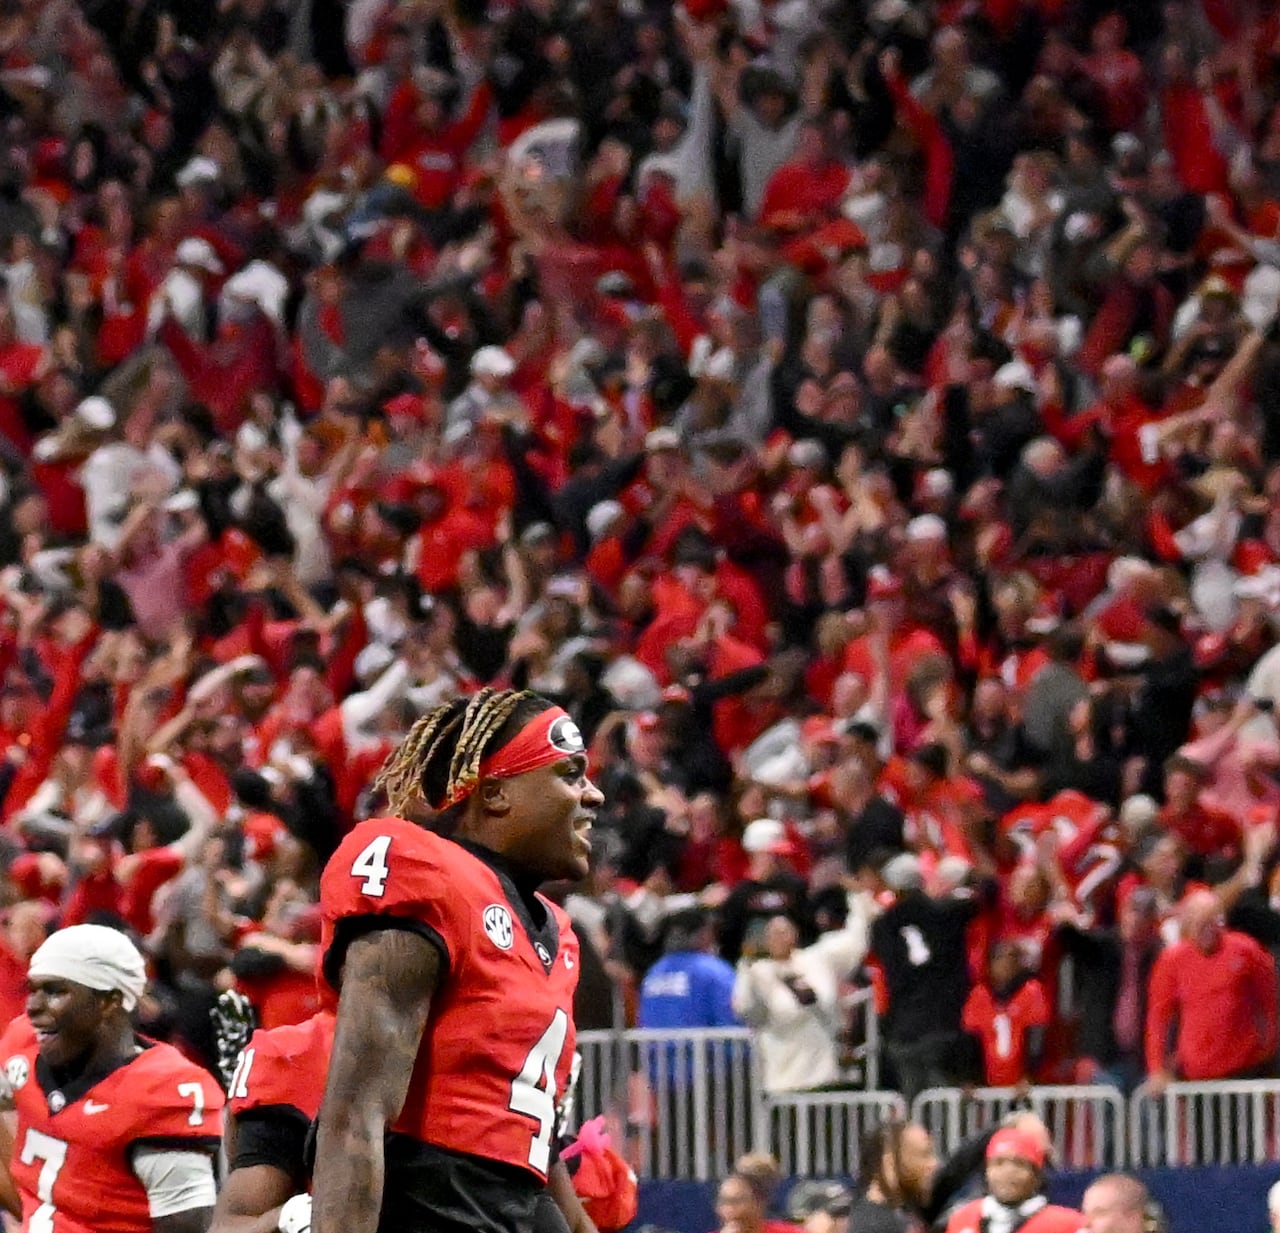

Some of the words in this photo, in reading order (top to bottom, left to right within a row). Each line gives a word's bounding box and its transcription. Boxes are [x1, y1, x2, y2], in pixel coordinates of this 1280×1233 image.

[350, 834, 393, 898] 4
[483, 904, 514, 950] SEC
[993, 1013, 1011, 1058] 1
[177, 1082, 206, 1126] 7
[508, 1008, 568, 1175] 4
